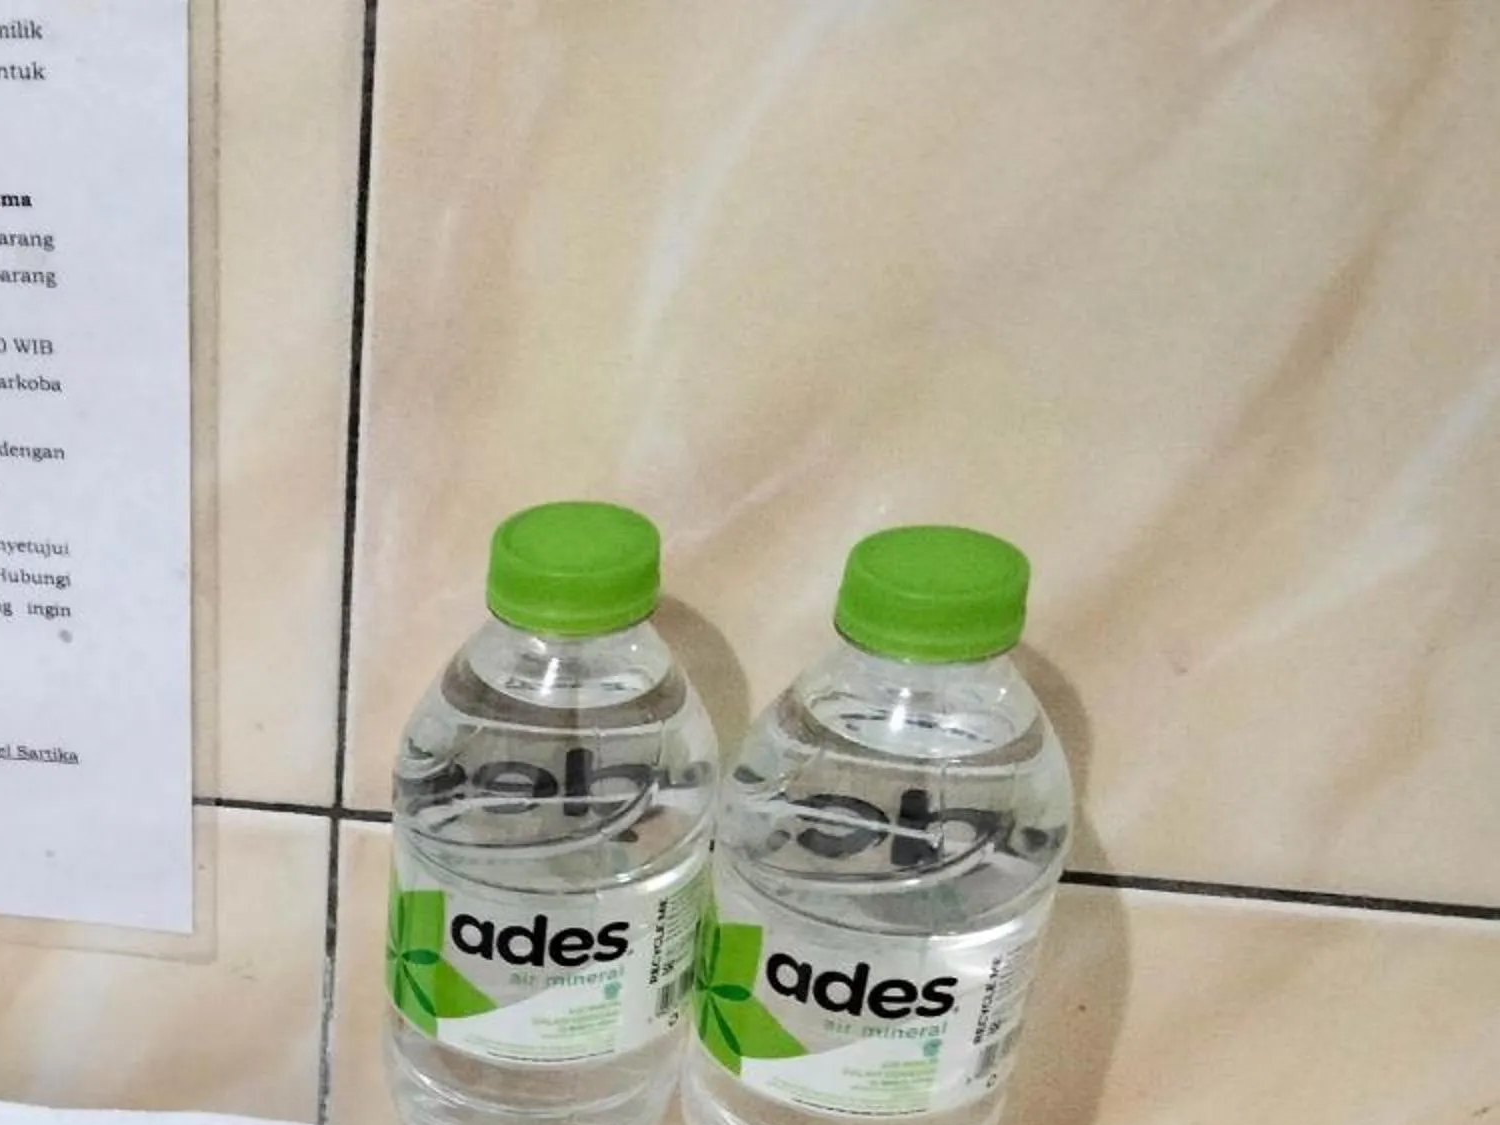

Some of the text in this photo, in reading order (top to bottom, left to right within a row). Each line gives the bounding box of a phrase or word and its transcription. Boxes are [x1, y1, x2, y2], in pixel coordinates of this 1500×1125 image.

[13, 337, 54, 356] WIB
[450, 913, 630, 968] ades
[765, 952, 959, 1019] ades
